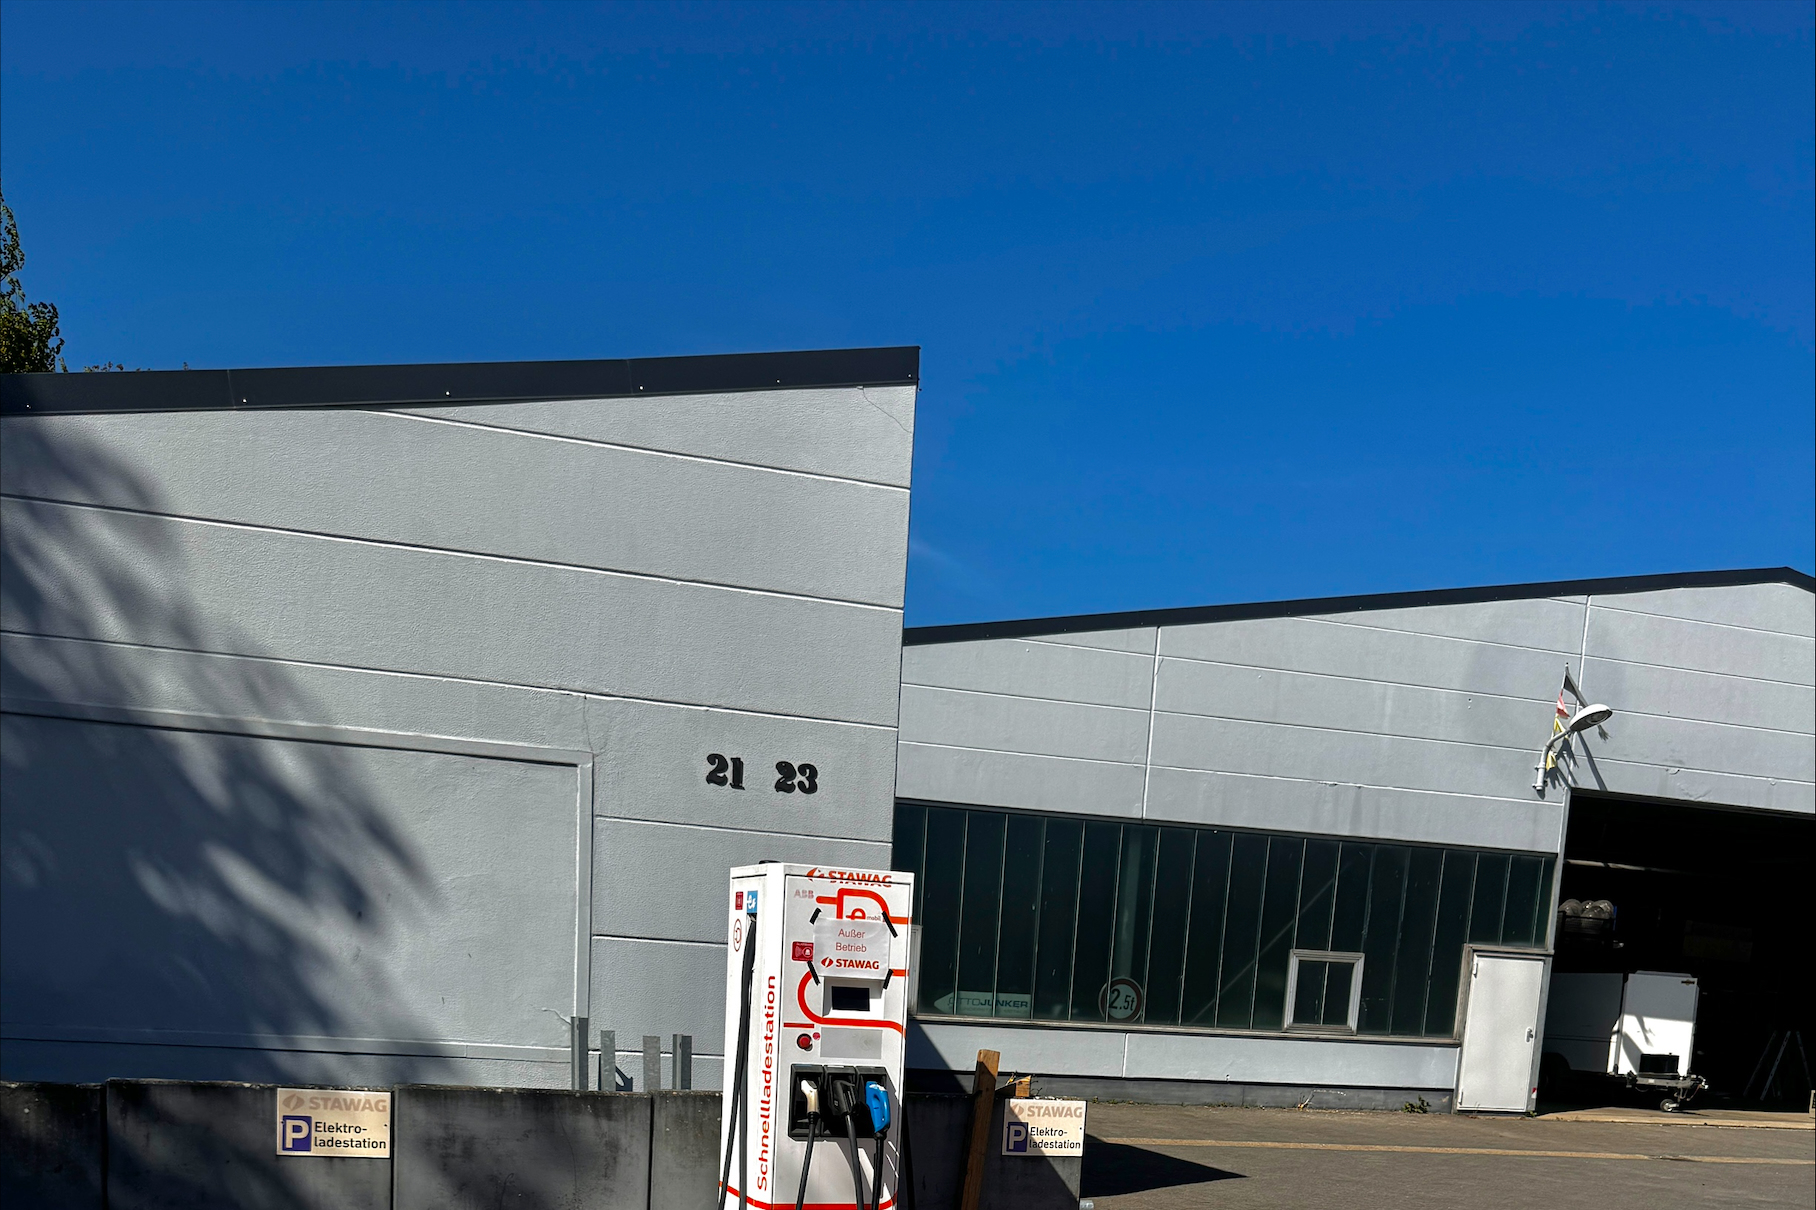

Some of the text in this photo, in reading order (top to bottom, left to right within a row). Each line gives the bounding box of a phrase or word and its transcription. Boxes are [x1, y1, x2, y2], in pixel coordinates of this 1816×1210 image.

[706, 753, 818, 794] 21 23
[828, 870, 892, 888] STAWAG
[794, 889, 814, 899] ABB
[838, 928, 866, 939] Außer
[835, 942, 867, 952] Betrieb
[836, 958, 879, 970] STAWAG
[757, 975, 776, 1191] Schnellladestation
[309, 1096, 387, 1113] STAWAG
[1027, 1105, 1083, 1118] STAWAG
[285, 1119, 309, 1148] P
[314, 1121, 367, 1134] Elektro-
[1030, 1126, 1067, 1136] Elektro-
[314, 1136, 386, 1149] ladestation
[1008, 1125, 1027, 1150] P
[1029, 1139, 1081, 1149] ladestation
